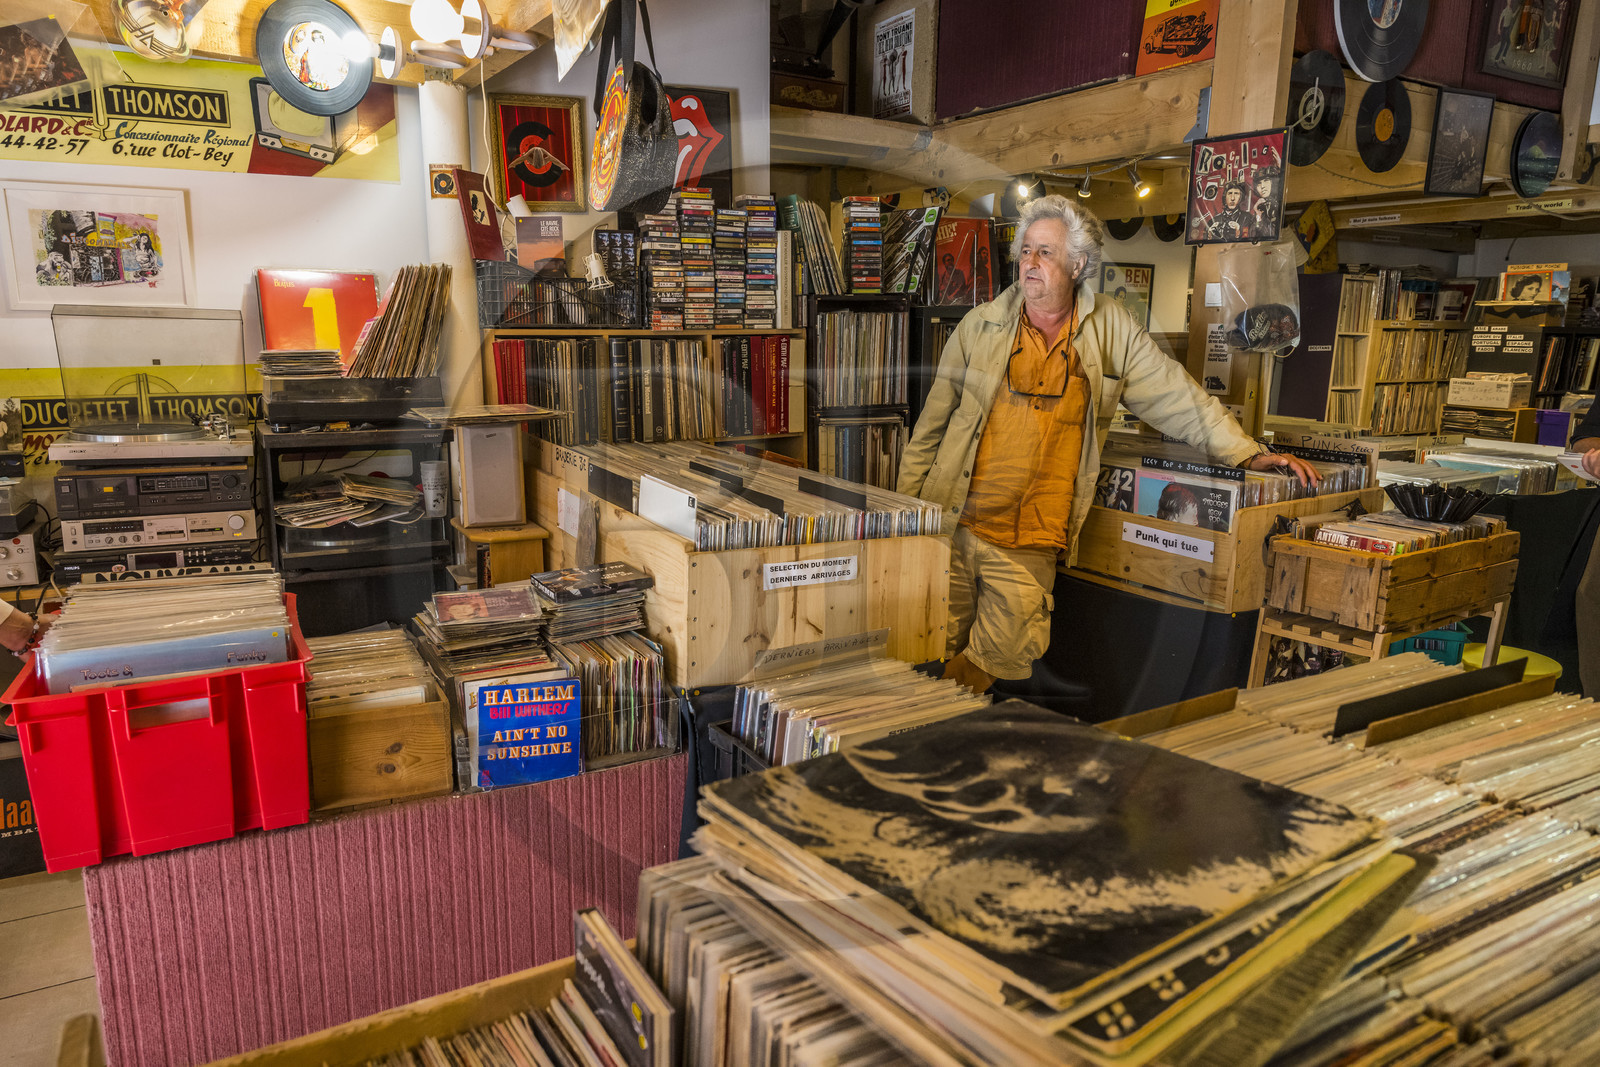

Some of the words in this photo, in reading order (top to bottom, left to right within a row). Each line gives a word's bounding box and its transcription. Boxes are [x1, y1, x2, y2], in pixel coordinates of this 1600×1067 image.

[891, 21, 913, 36] TRUANT
[108, 87, 222, 120] THOMSON
[115, 120, 200, 145] Concessionnaire
[203, 129, 252, 148] Régional
[1125, 268, 1149, 284] BEN
[303, 287, 342, 350] 1
[21, 399, 130, 426] DUCRETET
[154, 397, 257, 421] THOMSON
[1301, 435, 1342, 451] PUNK
[1432, 436, 1447, 446] JAZZ
[1162, 459, 1174, 468] POP
[1097, 466, 1134, 492] 242
[1202, 498, 1229, 509] STOOGES
[1209, 492, 1222, 501] THE
[1207, 508, 1223, 517] IGGY
[1208, 515, 1221, 523] POP
[1135, 529, 1159, 544] Punk
[1162, 538, 1178, 548] qui
[1181, 540, 1199, 553] tue
[1316, 531, 1350, 545] ANTOINE
[769, 562, 809, 573] SELECTION
[822, 558, 851, 567] MOMENT
[770, 574, 807, 584] DERNIERS
[811, 569, 851, 580] ARRIVAGES
[226, 649, 268, 663] Funky
[763, 648, 816, 664] DERNIERS
[823, 634, 880, 653] ARRIVAGES
[80, 667, 119, 681] Toots
[123, 664, 133, 677] &
[483, 684, 576, 706] HARLEM
[514, 702, 570, 717] WITHERS
[491, 727, 541, 743] AIN'T
[546, 725, 568, 738] NO
[487, 741, 572, 761] SUNSHINE
